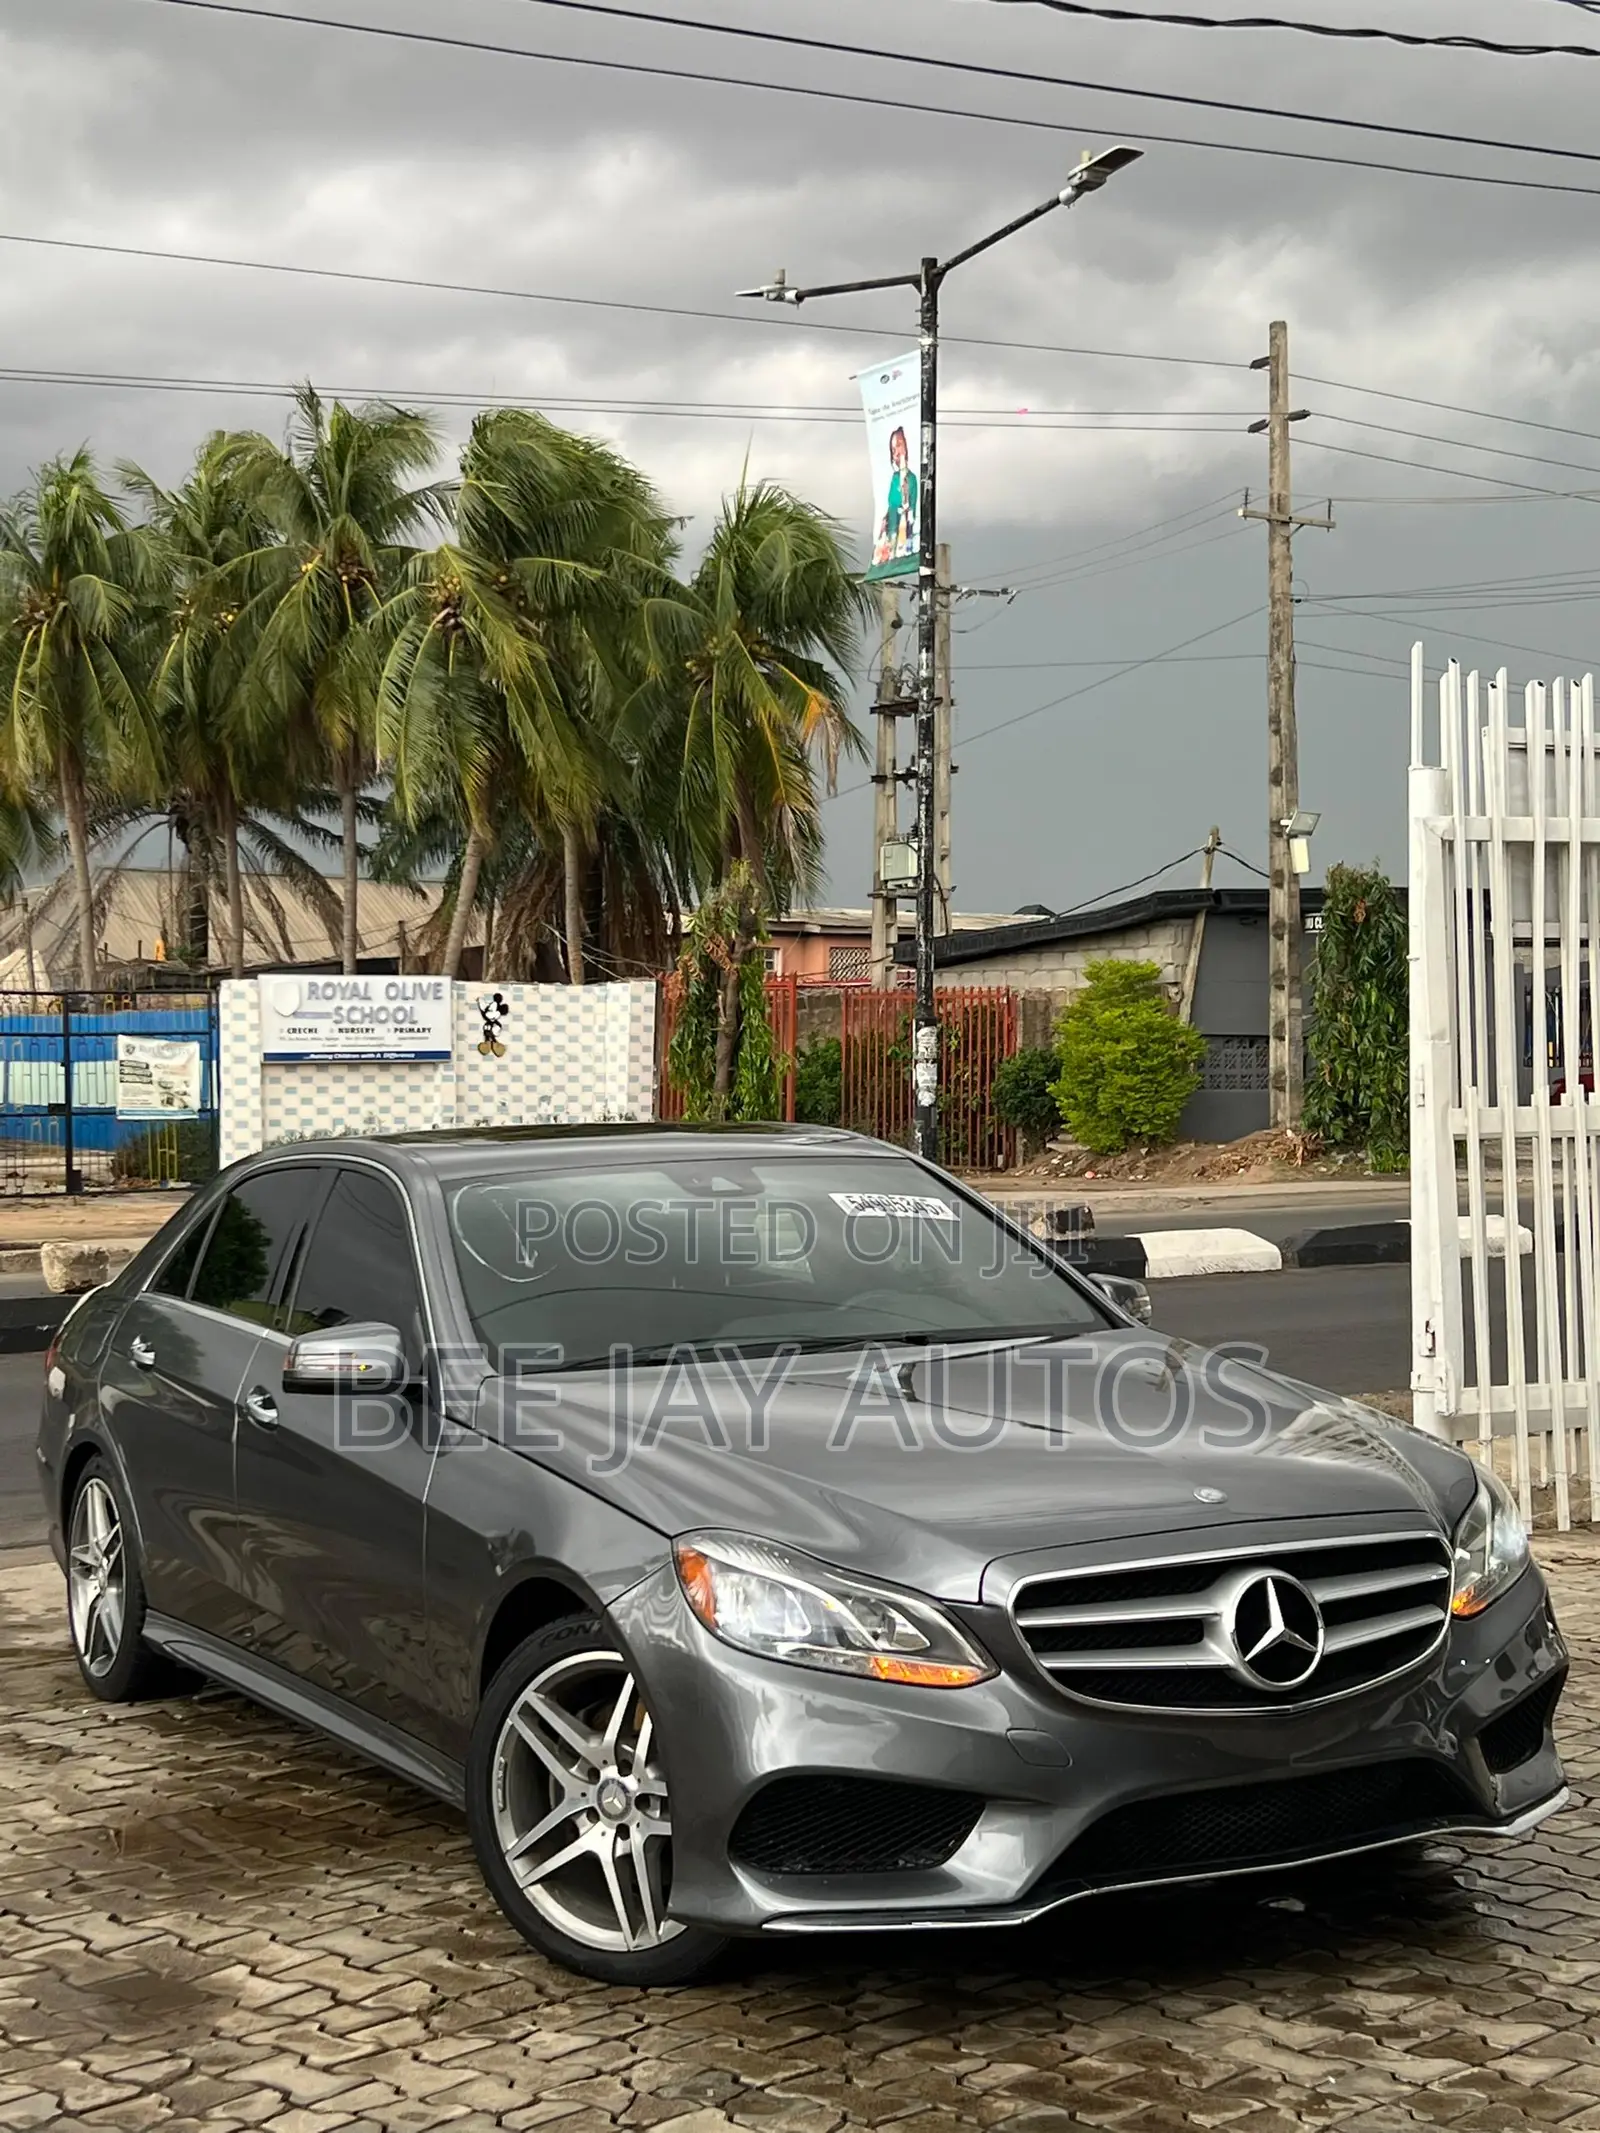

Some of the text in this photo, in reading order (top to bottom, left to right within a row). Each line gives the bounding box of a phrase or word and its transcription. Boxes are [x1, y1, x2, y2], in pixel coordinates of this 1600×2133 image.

[307, 981, 443, 1001] ROYAL OLIVE
[332, 1006, 418, 1025] SCHOOL
